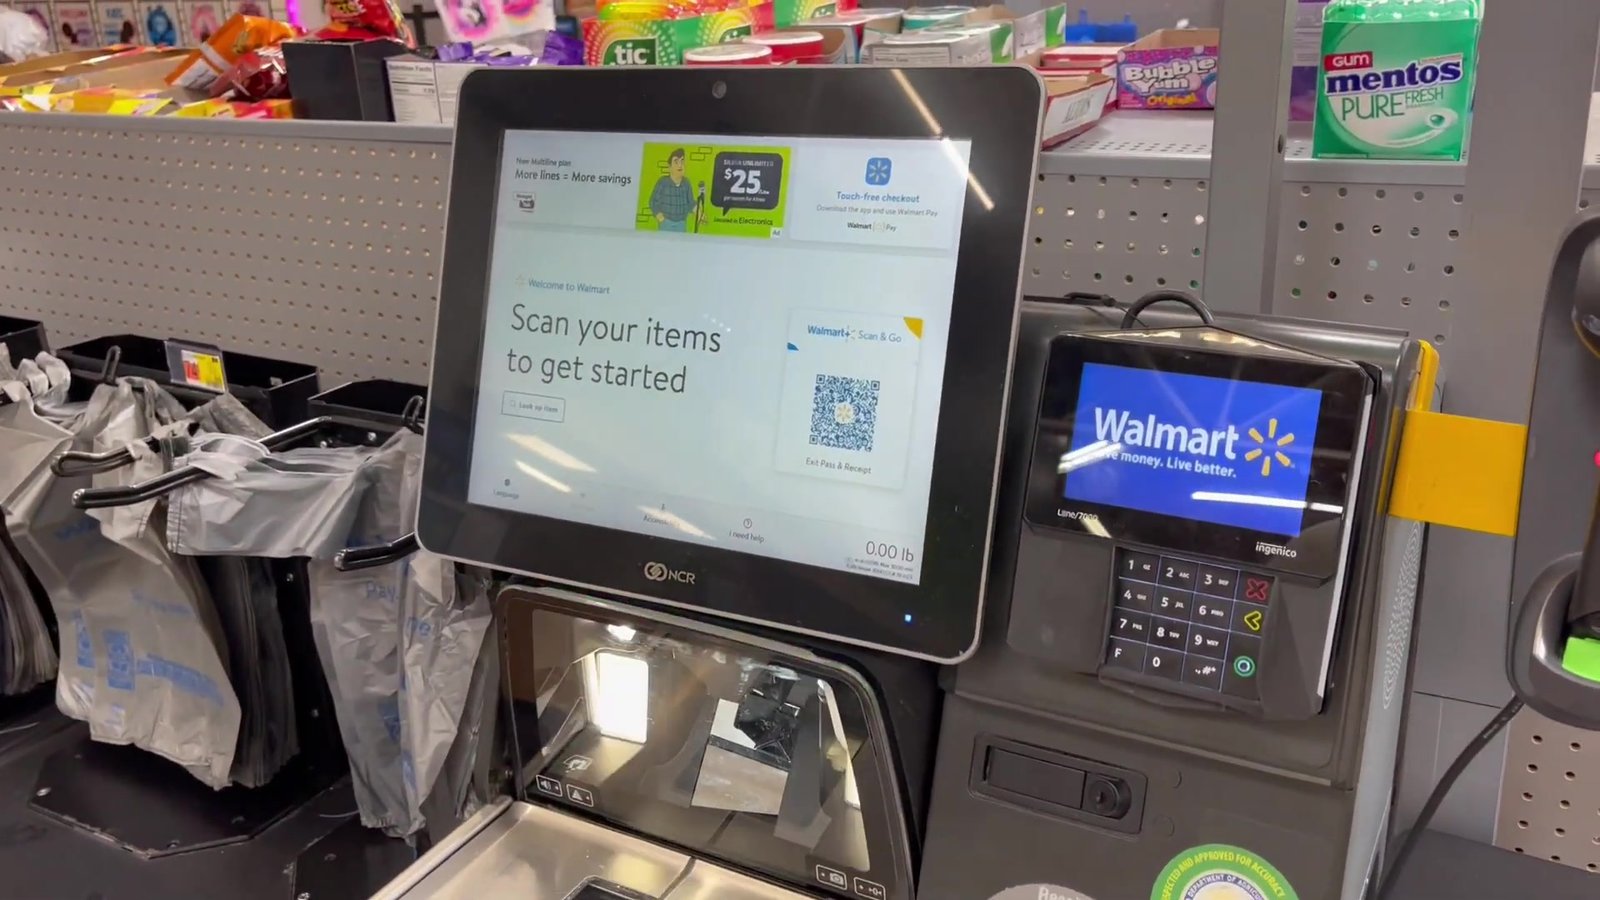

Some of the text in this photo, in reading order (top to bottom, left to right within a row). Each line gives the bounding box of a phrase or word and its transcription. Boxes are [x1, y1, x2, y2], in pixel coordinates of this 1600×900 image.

[614, 43, 647, 65] tic
[1124, 58, 1216, 81] Bubble
[1326, 61, 1462, 93] mentos
[1131, 78, 1189, 94] Yum
[1341, 87, 1444, 121] PURE FRESH
[515, 169, 538, 180] More
[540, 169, 560, 181] lines
[571, 171, 596, 183] More
[598, 173, 632, 187] savings
[836, 191, 920, 203] Touch-free checkout
[925, 209, 938, 218] Pay
[847, 222, 897, 232] Walmart Pay
[528, 279, 610, 295] Welcome to Walmart
[511, 303, 721, 353] Scan your items
[858, 330, 878, 341] Scan
[880, 332, 887, 341] &
[889, 333, 902, 343] Go
[507, 349, 687, 393] to get started
[1095, 407, 1239, 460] Walmart
[806, 457, 819, 467] Exit
[820, 459, 836, 470] Pass
[844, 463, 872, 474] Receipt
[1121, 452, 1164, 469] money.
[1167, 457, 1192, 472] Live
[1196, 462, 1237, 478] better.
[732, 531, 750, 541] need
[751, 533, 765, 544] help
[866, 541, 914, 562] 0.00 lb
[1255, 541, 1297, 558] ingenico
[1128, 560, 1134, 570] 1
[1166, 567, 1174, 578] 2
[668, 569, 696, 585] NCR
[1204, 574, 1212, 585] 3
[1124, 590, 1132, 600] 4
[1161, 597, 1168, 607] 5
[1199, 605, 1207, 615] 6
[1119, 618, 1128, 629] 7
[1157, 627, 1165, 638] 8
[1194, 635, 1203, 646] 9
[1114, 649, 1122, 658] F
[1152, 657, 1161, 667] 0
[1178, 857, 1194, 872] AND
[1194, 851, 1235, 864] APPROVED
[1236, 854, 1252, 867] FOR
[1251, 862, 1286, 897] ACCURACY
[1188, 874, 1224, 897] DEPARTMENT
[1226, 875, 1237, 883] OF
